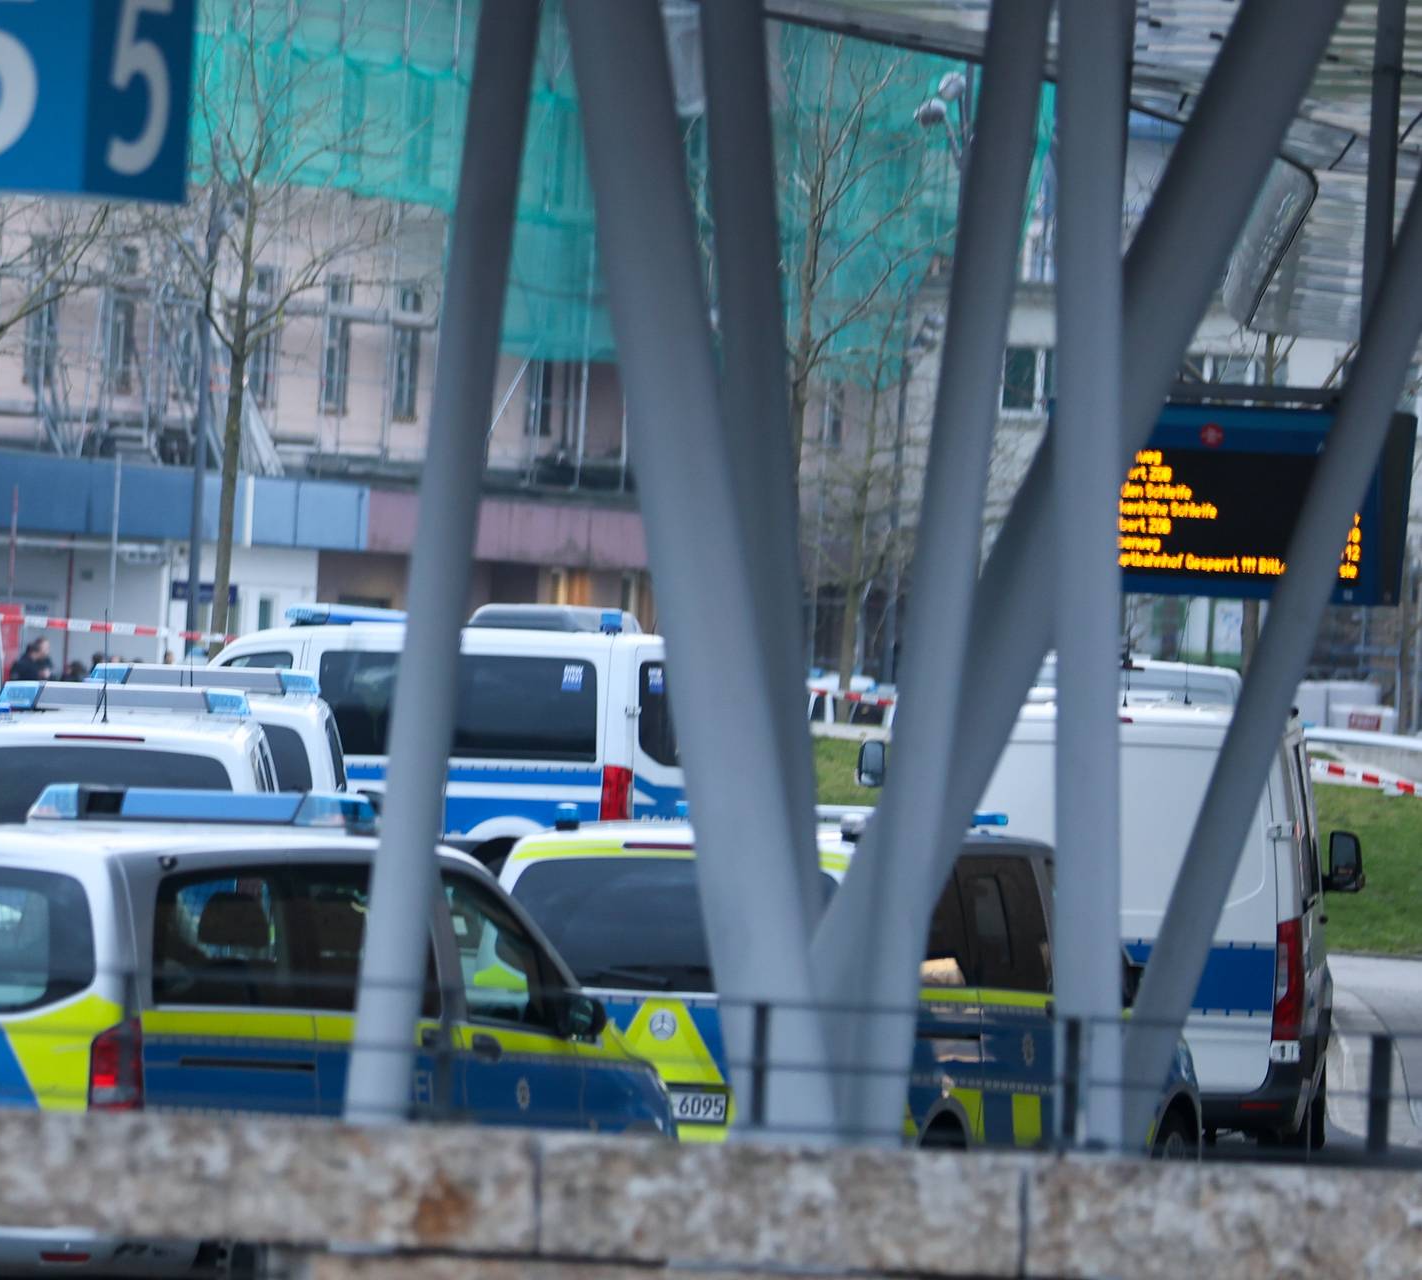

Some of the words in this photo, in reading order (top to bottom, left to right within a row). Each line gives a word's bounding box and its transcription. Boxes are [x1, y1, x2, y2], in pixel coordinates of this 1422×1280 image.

[105, 0, 170, 175] 5
[1145, 482, 1192, 500] Schleife
[1170, 501, 1218, 519] Schleife
[1185, 553, 1238, 573] Gesperrt
[679, 1095, 725, 1116] 6095
